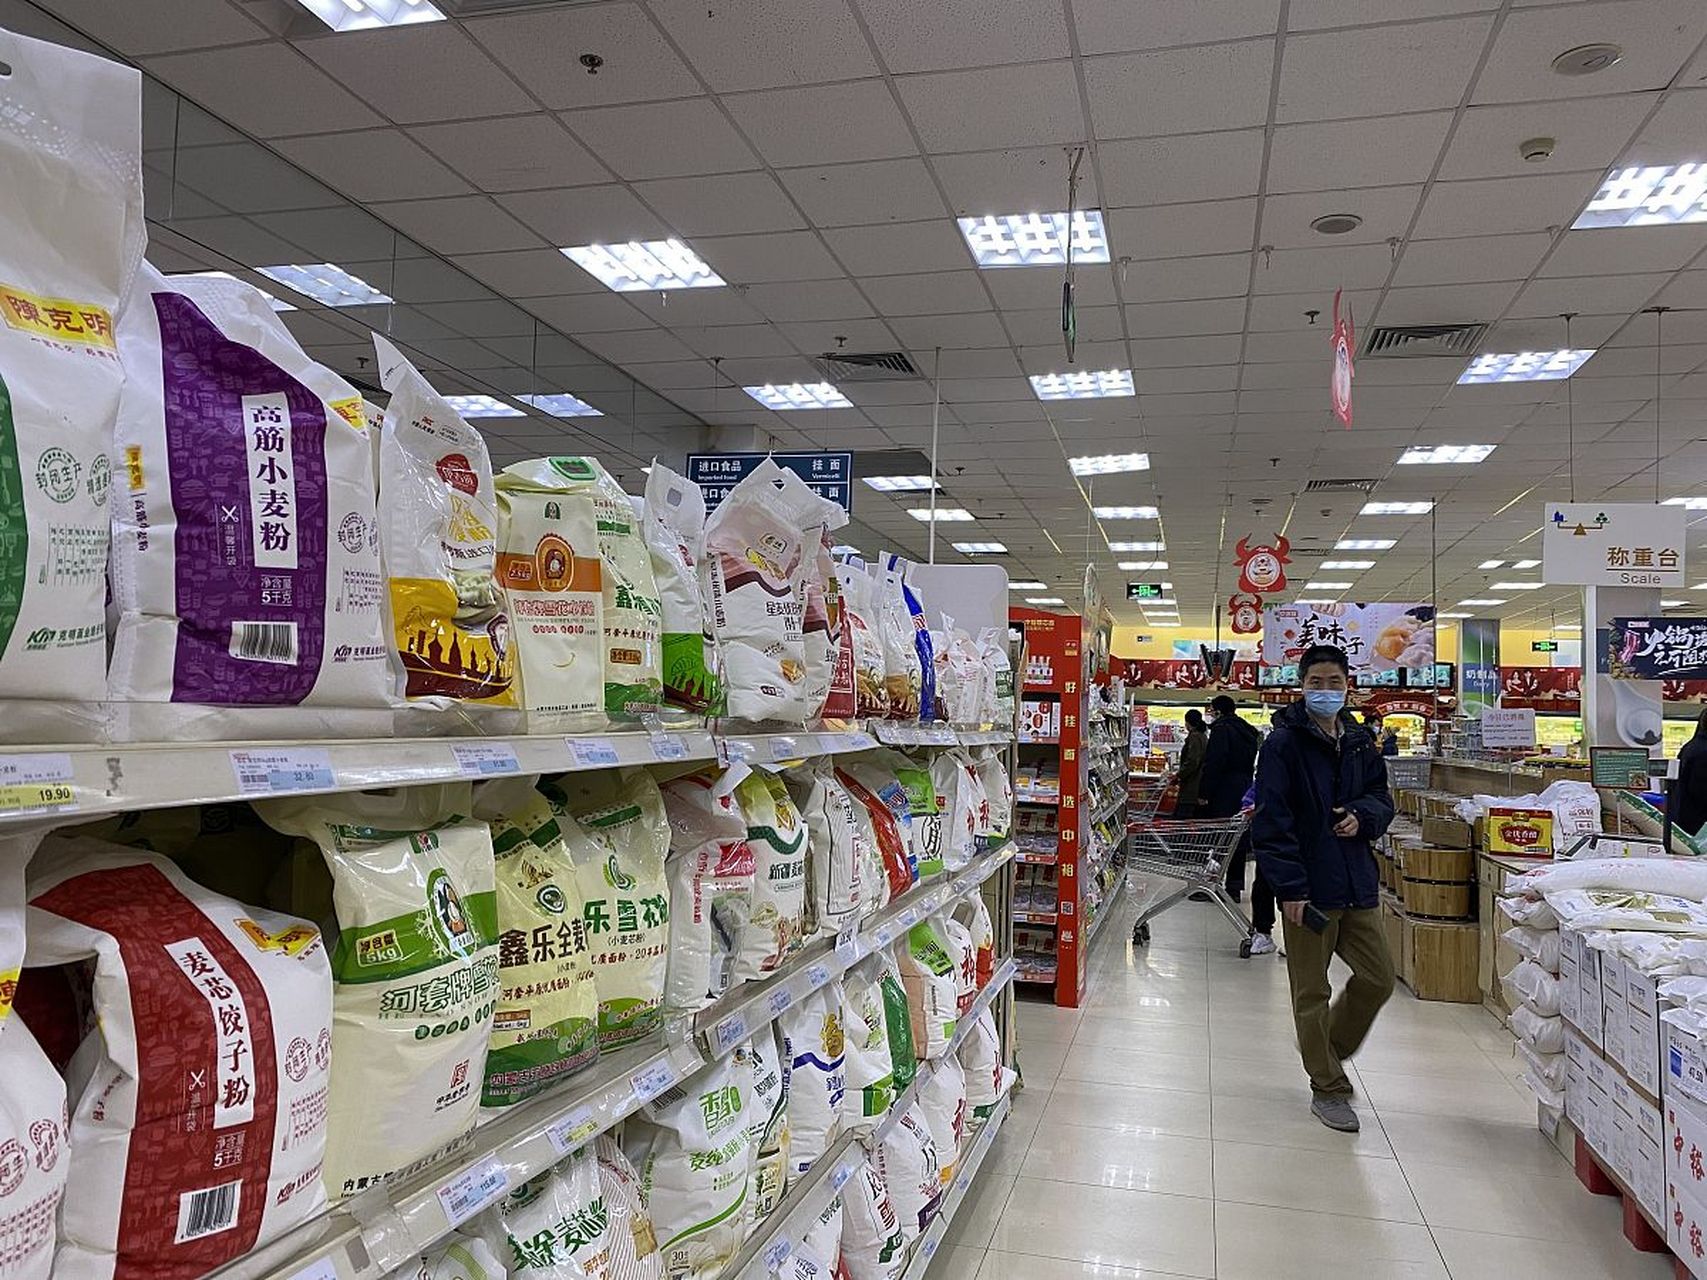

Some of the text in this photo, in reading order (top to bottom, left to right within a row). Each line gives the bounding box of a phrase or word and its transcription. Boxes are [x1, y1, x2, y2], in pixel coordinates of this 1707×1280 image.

[698, 460, 742, 472] 进口食品
[812, 459, 840, 471] 挂面
[249, 405, 292, 552] 高筋小麦粉
[1607, 547, 1680, 568] 称重台
[261, 577, 292, 589] 净含量
[1620, 572, 1661, 585] Scale
[261, 591, 293, 604] 5千克
[40, 787, 70, 801] 19.90
[360, 933, 395, 951] 净含量
[366, 949, 398, 963] 5kg
[179, 950, 251, 1109] 麦芯饺子粉
[213, 1151, 243, 1168] 5千克
